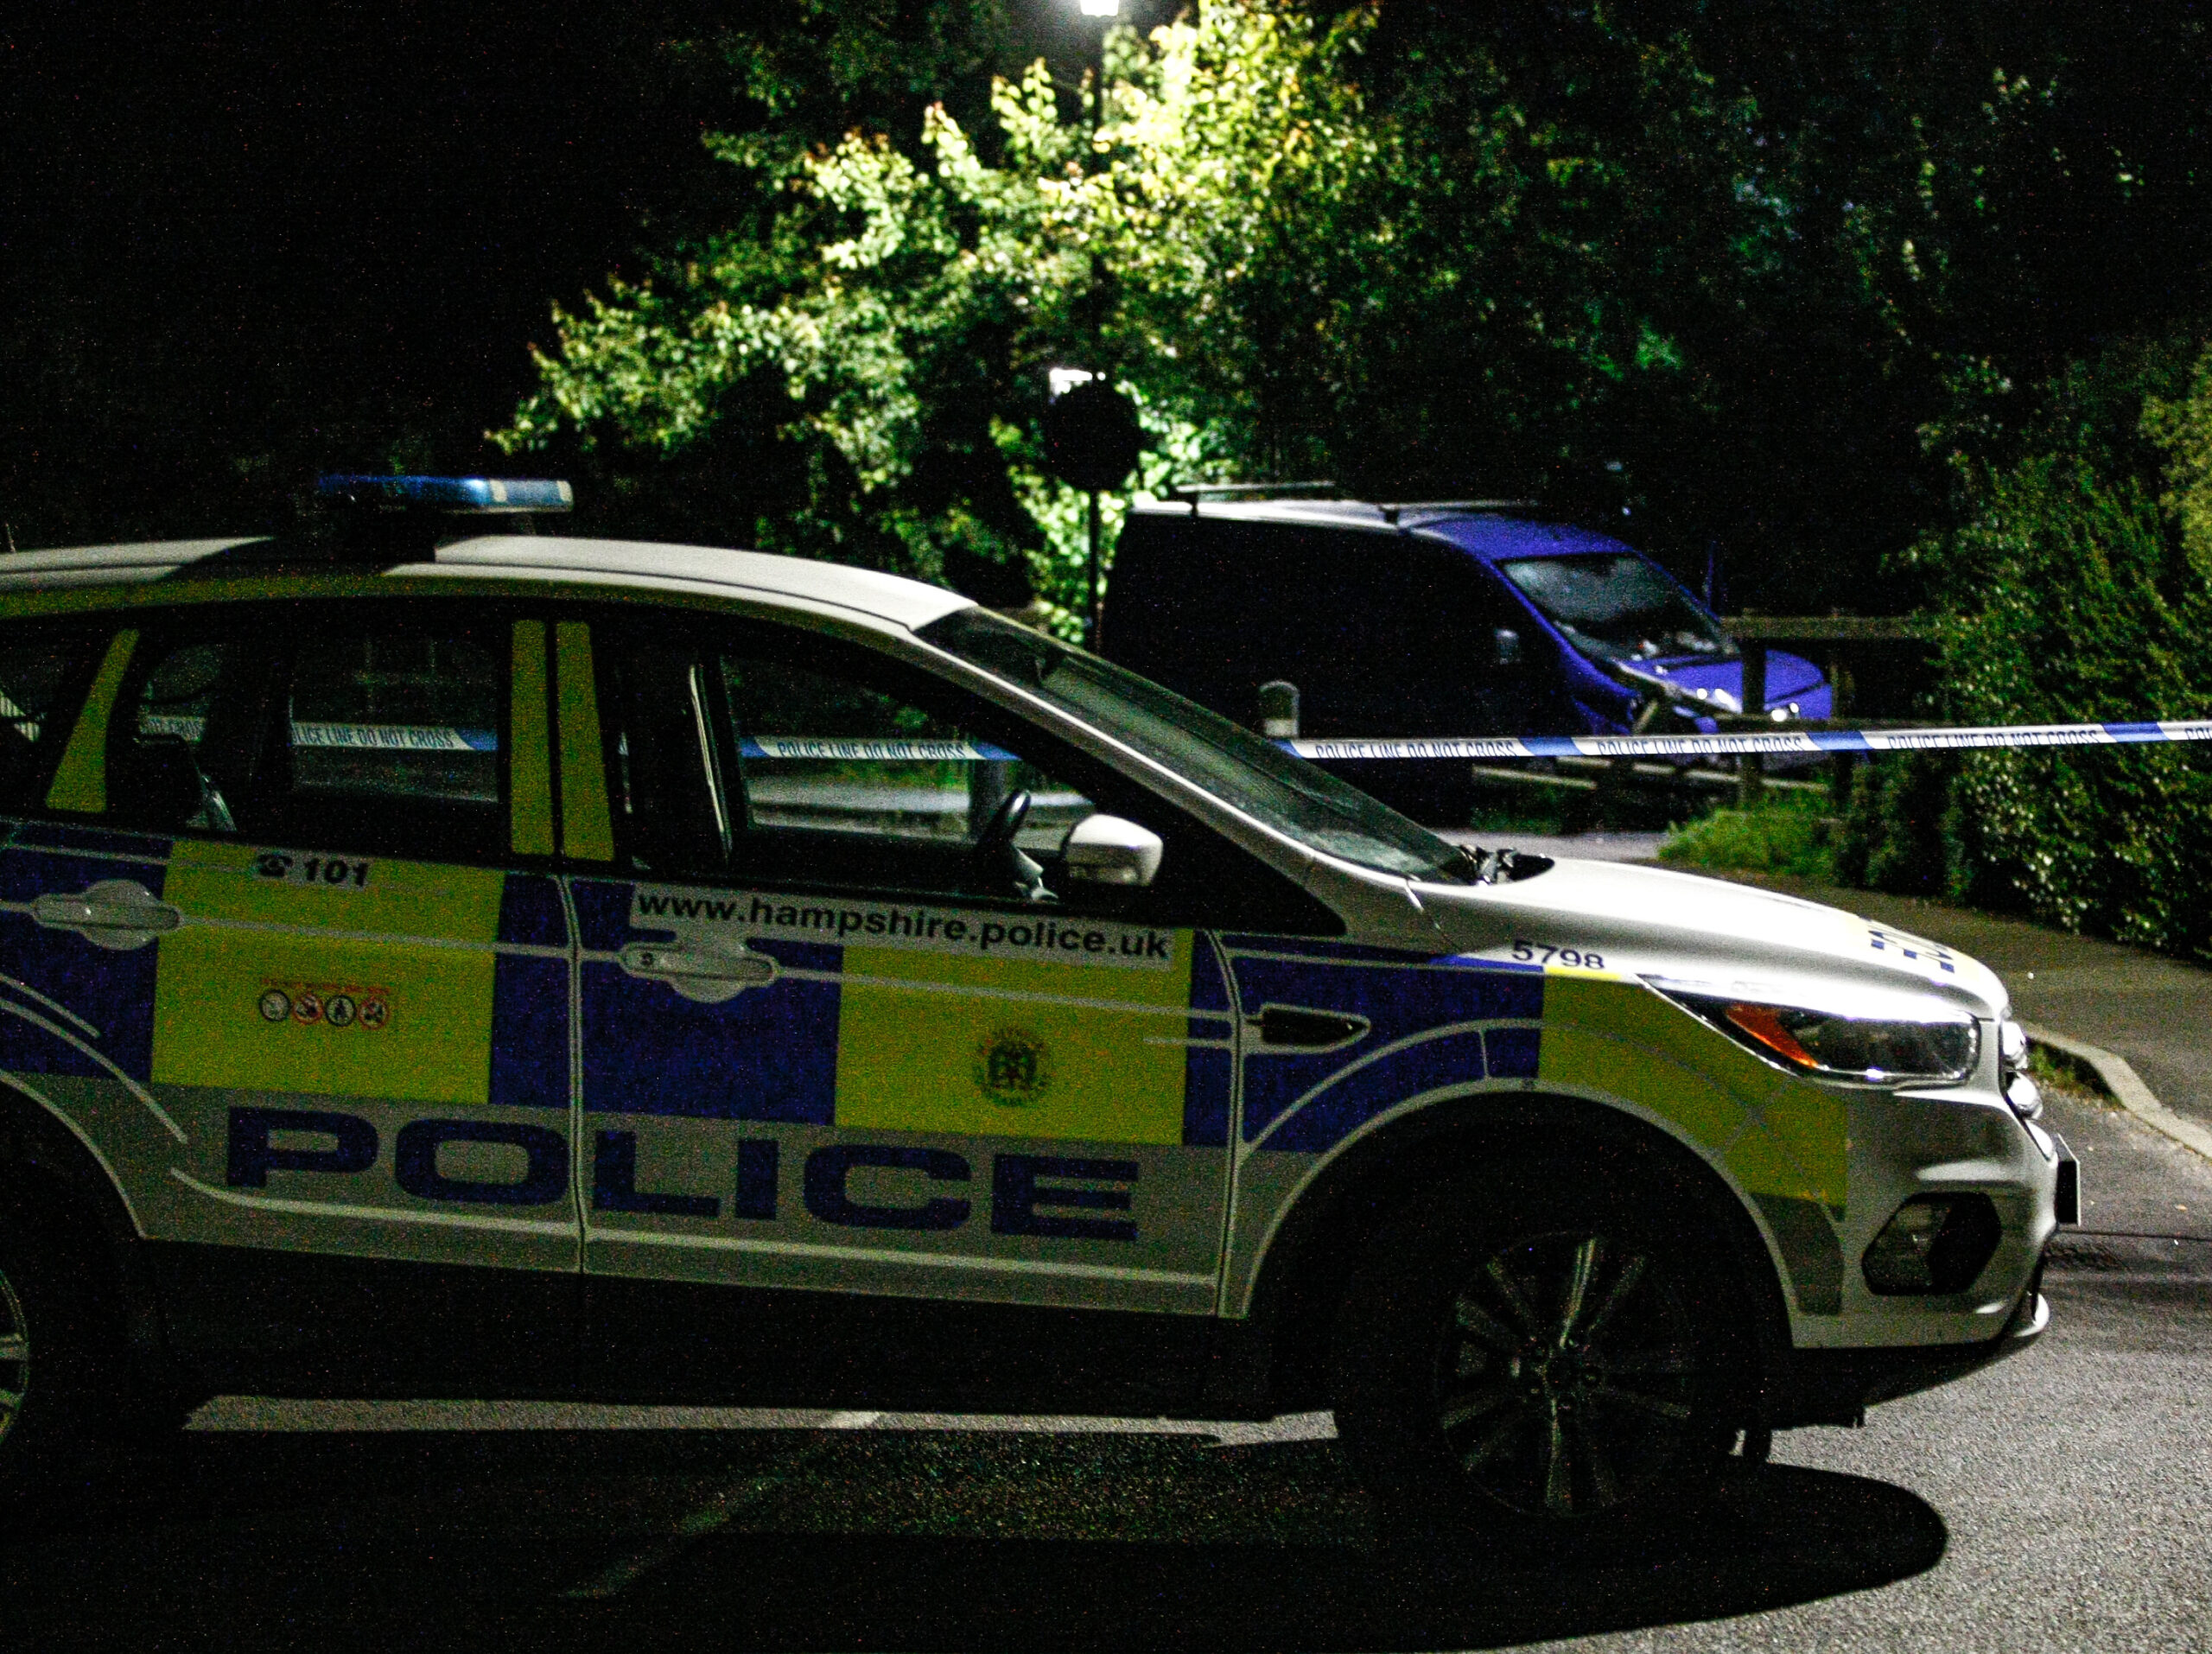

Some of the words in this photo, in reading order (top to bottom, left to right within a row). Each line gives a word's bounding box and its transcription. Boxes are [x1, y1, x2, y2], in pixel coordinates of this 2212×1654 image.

[357, 728, 378, 746] DO
[381, 728, 407, 747] NOT
[411, 728, 455, 747] CROSS
[1599, 741, 1649, 754] POLICE
[1653, 740, 1686, 754] LINE
[1691, 740, 1713, 754] DO
[1717, 739, 1747, 753] NOT
[1751, 737, 1805, 752] CROSS
[1886, 735, 1938, 749] POLICE
[1944, 735, 1979, 748] LINE
[1984, 734, 2005, 747] DO
[2011, 732, 2043, 747] NOT
[2046, 730, 2100, 745] CROSS
[777, 741, 824, 758] POLICE
[829, 742, 861, 759] LINE
[863, 743, 883, 760] DO
[886, 743, 914, 760] NOT
[918, 742, 967, 760] CROSS
[1315, 741, 1366, 758] POLICE
[1370, 742, 1402, 758] LINE
[1407, 742, 1428, 758] DO
[1431, 741, 1462, 757] NOT
[1465, 741, 1518, 757] CROSS
[304, 856, 369, 887] 101
[638, 891, 1170, 959] www.hampshire.police.uk
[1511, 939, 1605, 970] 5798
[226, 1105, 1140, 1243] POLICE
